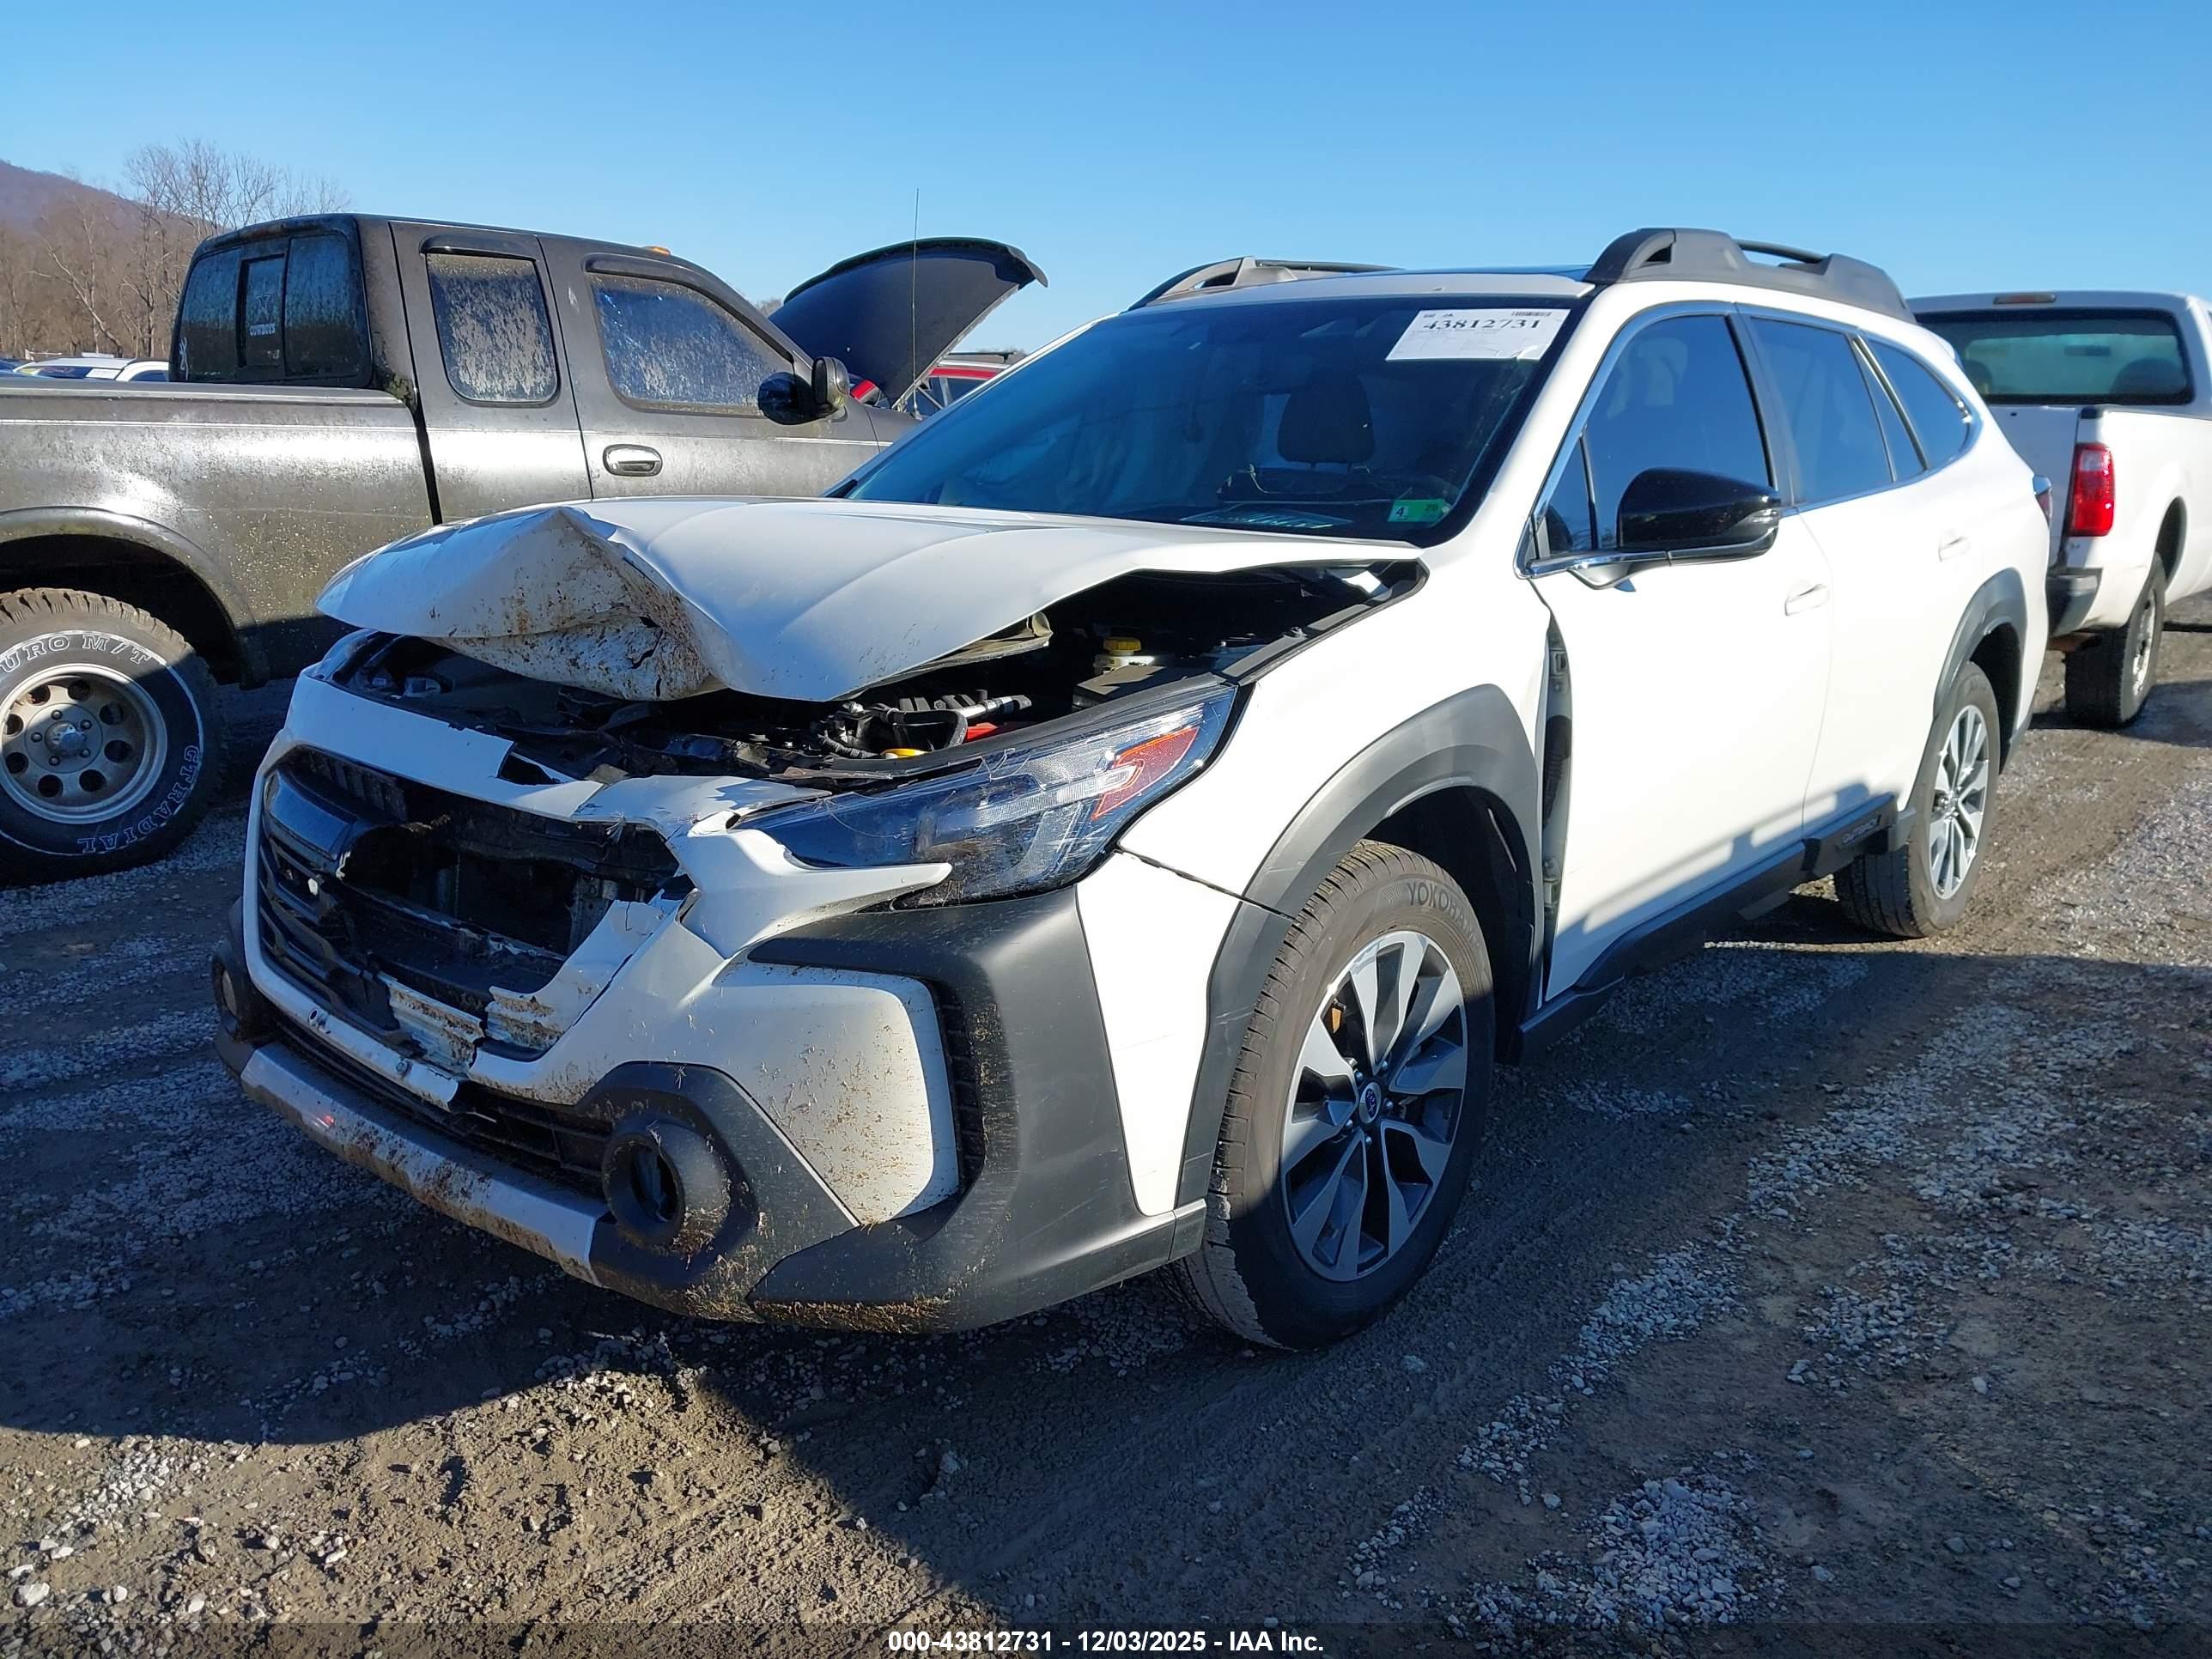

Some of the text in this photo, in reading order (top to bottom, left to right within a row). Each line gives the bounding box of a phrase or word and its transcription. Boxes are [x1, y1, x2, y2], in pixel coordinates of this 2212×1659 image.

[249, 322, 275, 337] COWBOYS
[1422, 319, 1541, 330] 43812731
[1395, 507, 1405, 517] 4
[82, 634, 151, 665] M/T
